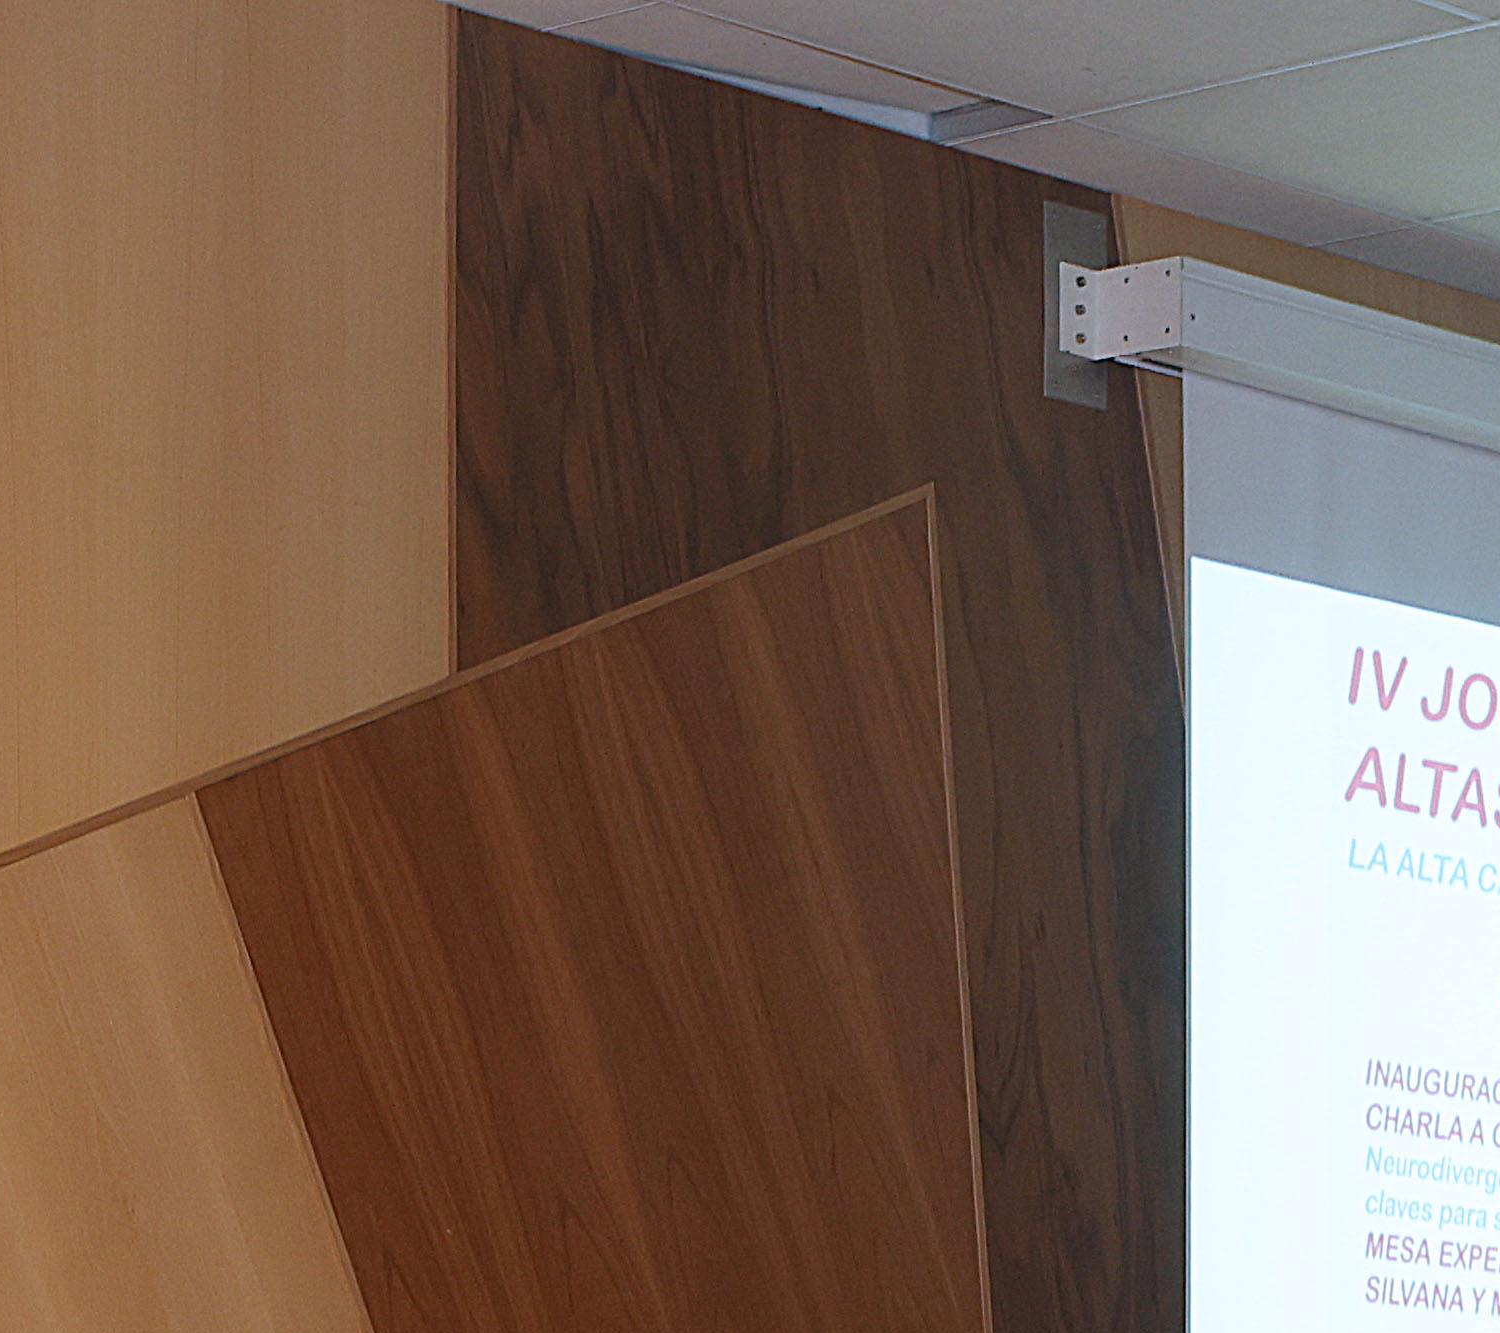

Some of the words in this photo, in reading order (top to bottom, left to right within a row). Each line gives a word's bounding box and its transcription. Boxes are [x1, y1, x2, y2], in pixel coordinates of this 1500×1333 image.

[1348, 646, 1408, 711] IV
[1348, 838, 1388, 874] LA
[1396, 847, 1469, 888] ALTA
[1365, 1103, 1463, 1143] CHARLA
[1469, 1118, 1485, 1147] A
[1364, 1189, 1433, 1222] claves
[1438, 1204, 1488, 1230] para
[1365, 1231, 1432, 1266] MESA
[1365, 1275, 1465, 1313] SILVANA
[1472, 1286, 1487, 1315] Y
